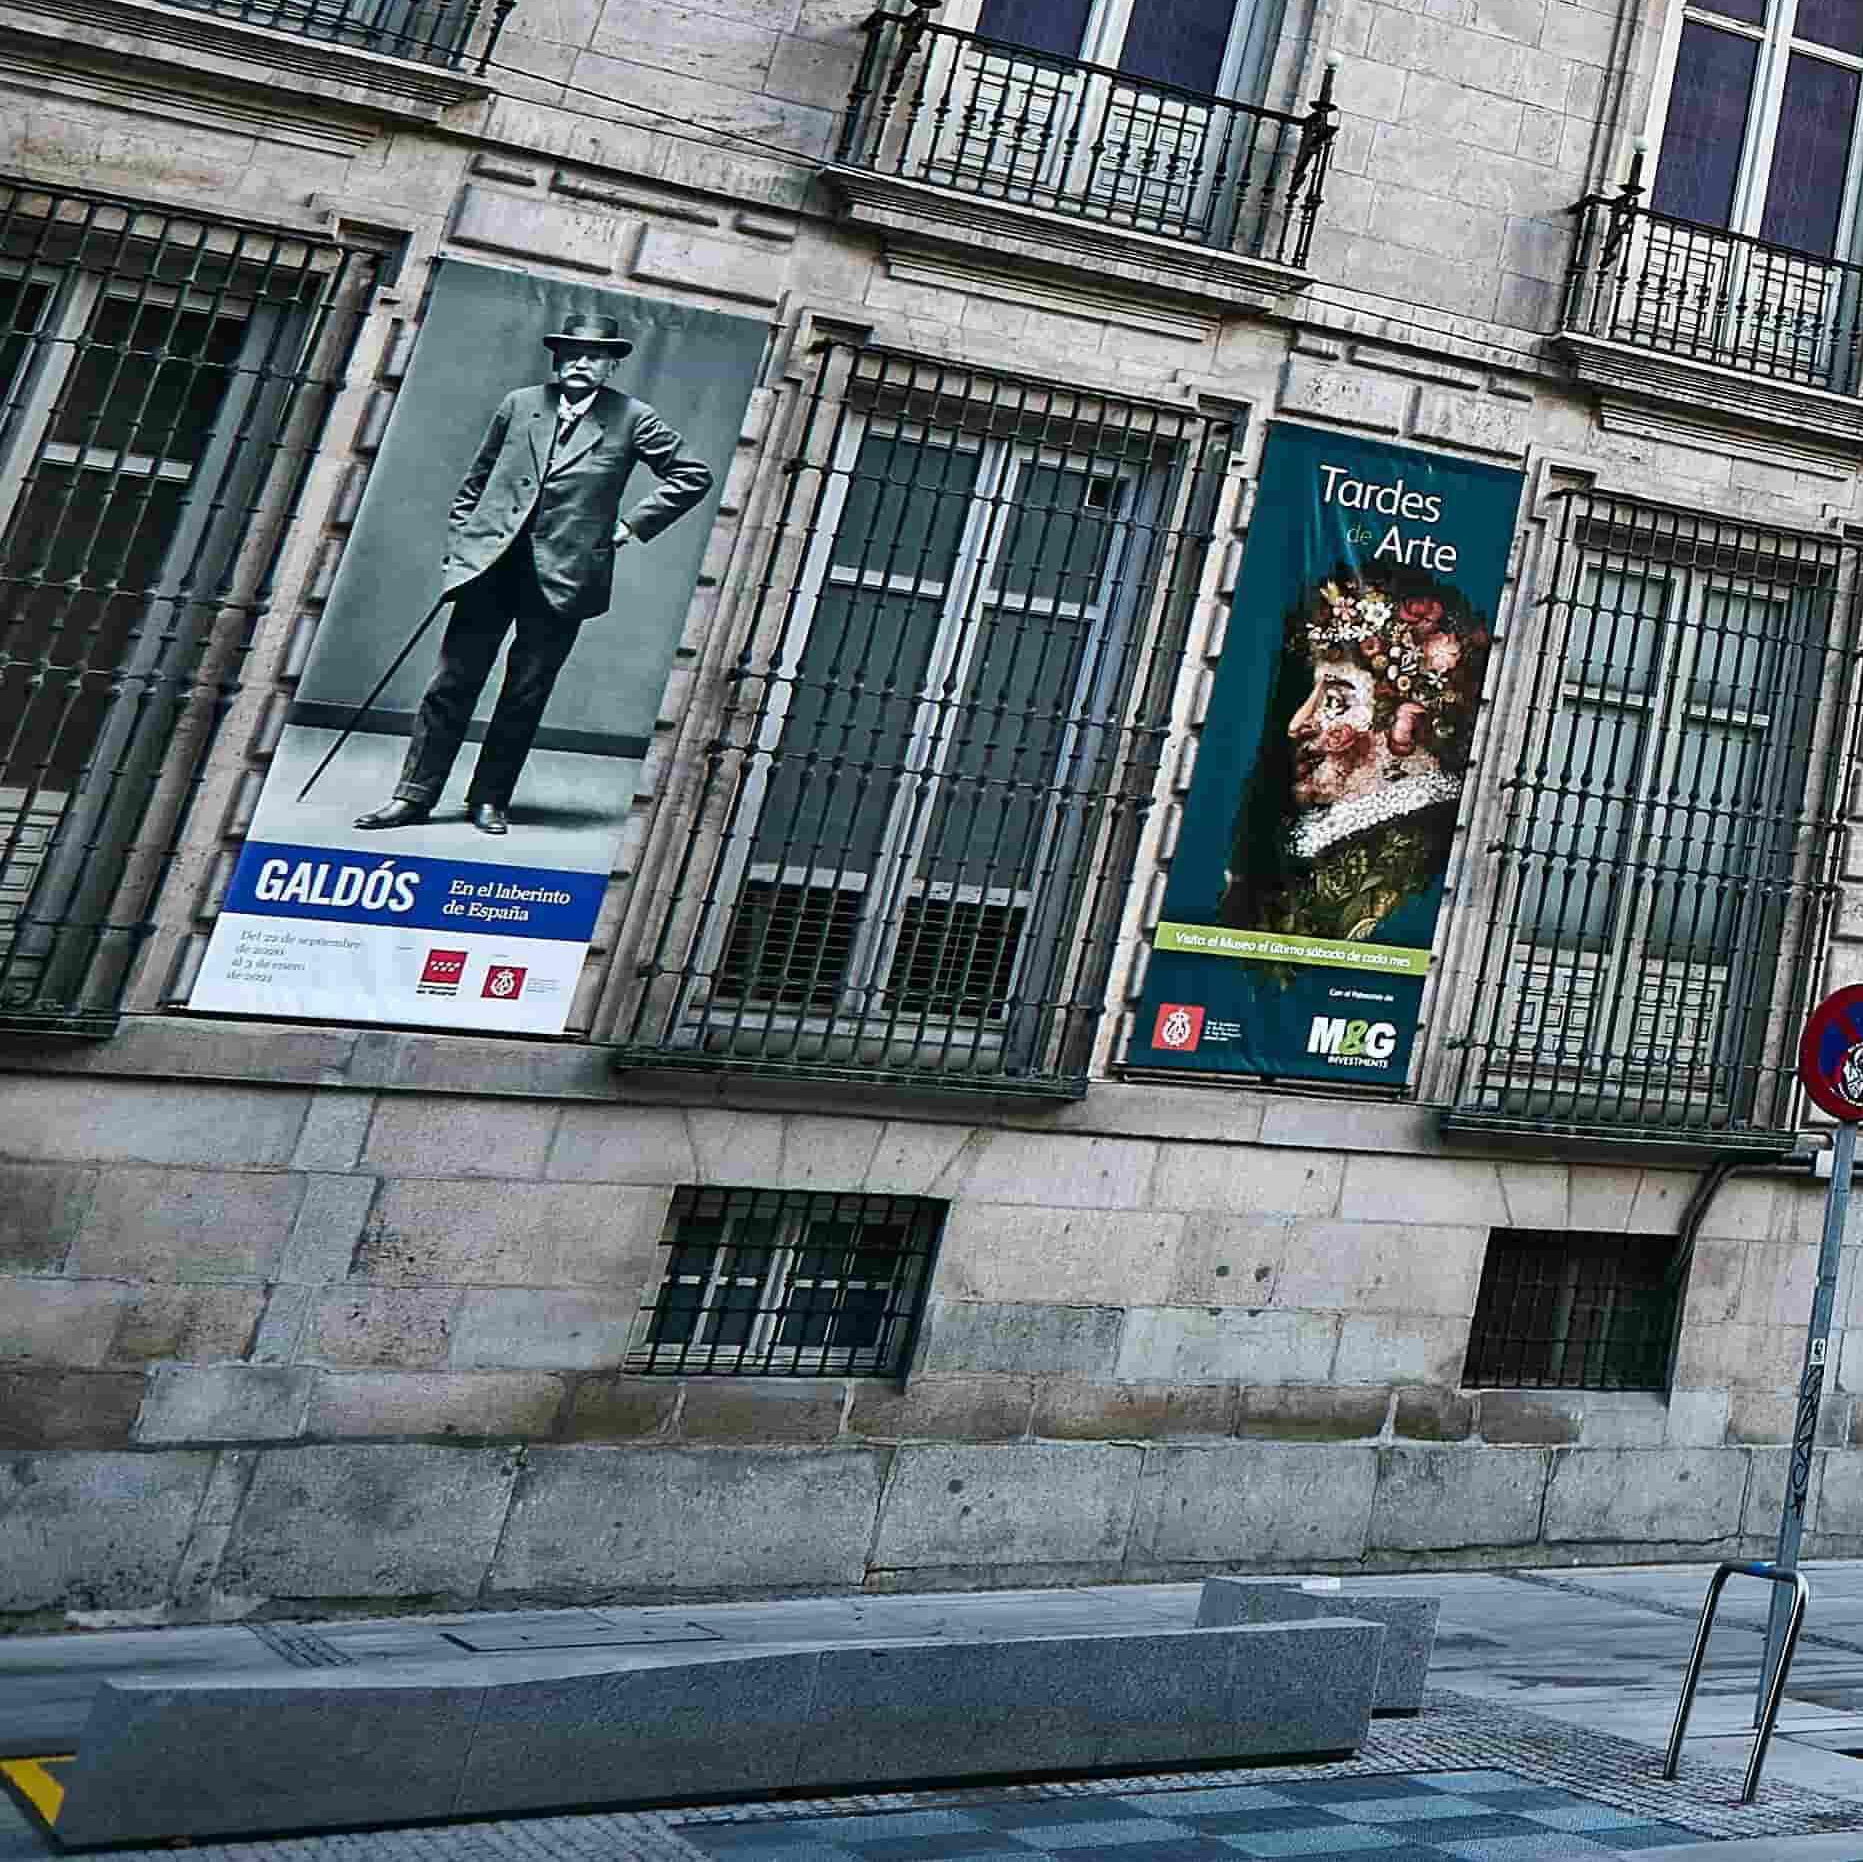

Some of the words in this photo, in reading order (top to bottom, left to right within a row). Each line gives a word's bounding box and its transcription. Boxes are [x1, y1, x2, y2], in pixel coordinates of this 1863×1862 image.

[1319, 464, 1441, 523] Tardes
[1346, 523, 1373, 545] de
[1373, 526, 1457, 572] Arte
[255, 859, 420, 912] GALDÓS
[449, 879, 474, 896] En
[477, 882, 494, 898] el
[496, 883, 571, 905] laberinto
[442, 899, 465, 915] de
[467, 902, 529, 922] España
[1307, 1016, 1397, 1059] M&G
